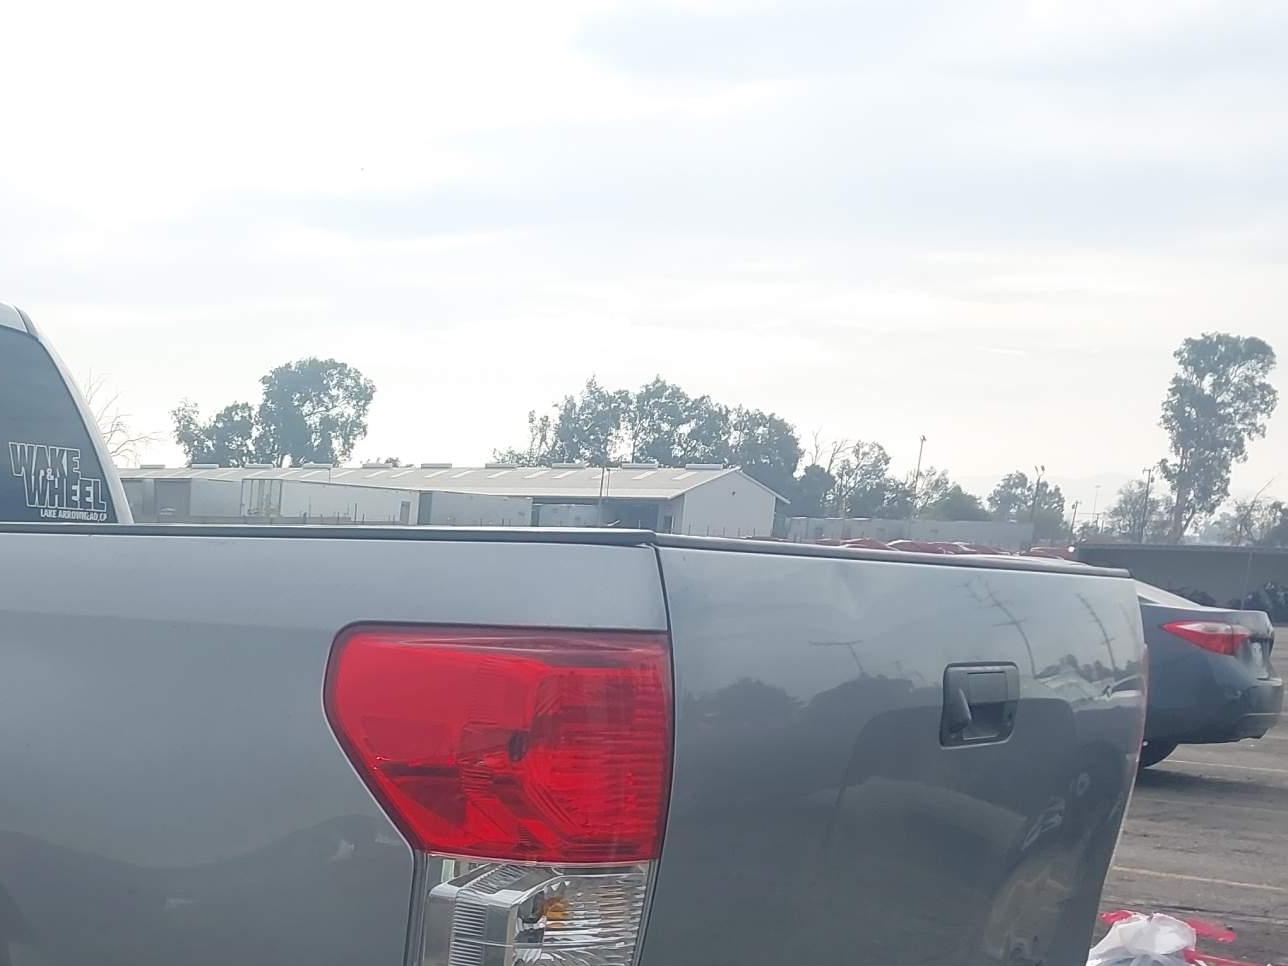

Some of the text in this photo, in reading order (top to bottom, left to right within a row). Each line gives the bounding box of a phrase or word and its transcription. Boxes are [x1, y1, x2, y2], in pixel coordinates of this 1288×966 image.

[9, 442, 80, 476] WAKE
[46, 467, 55, 481] &
[24, 476, 106, 512] WHEEL
[40, 508, 57, 518] LAKE
